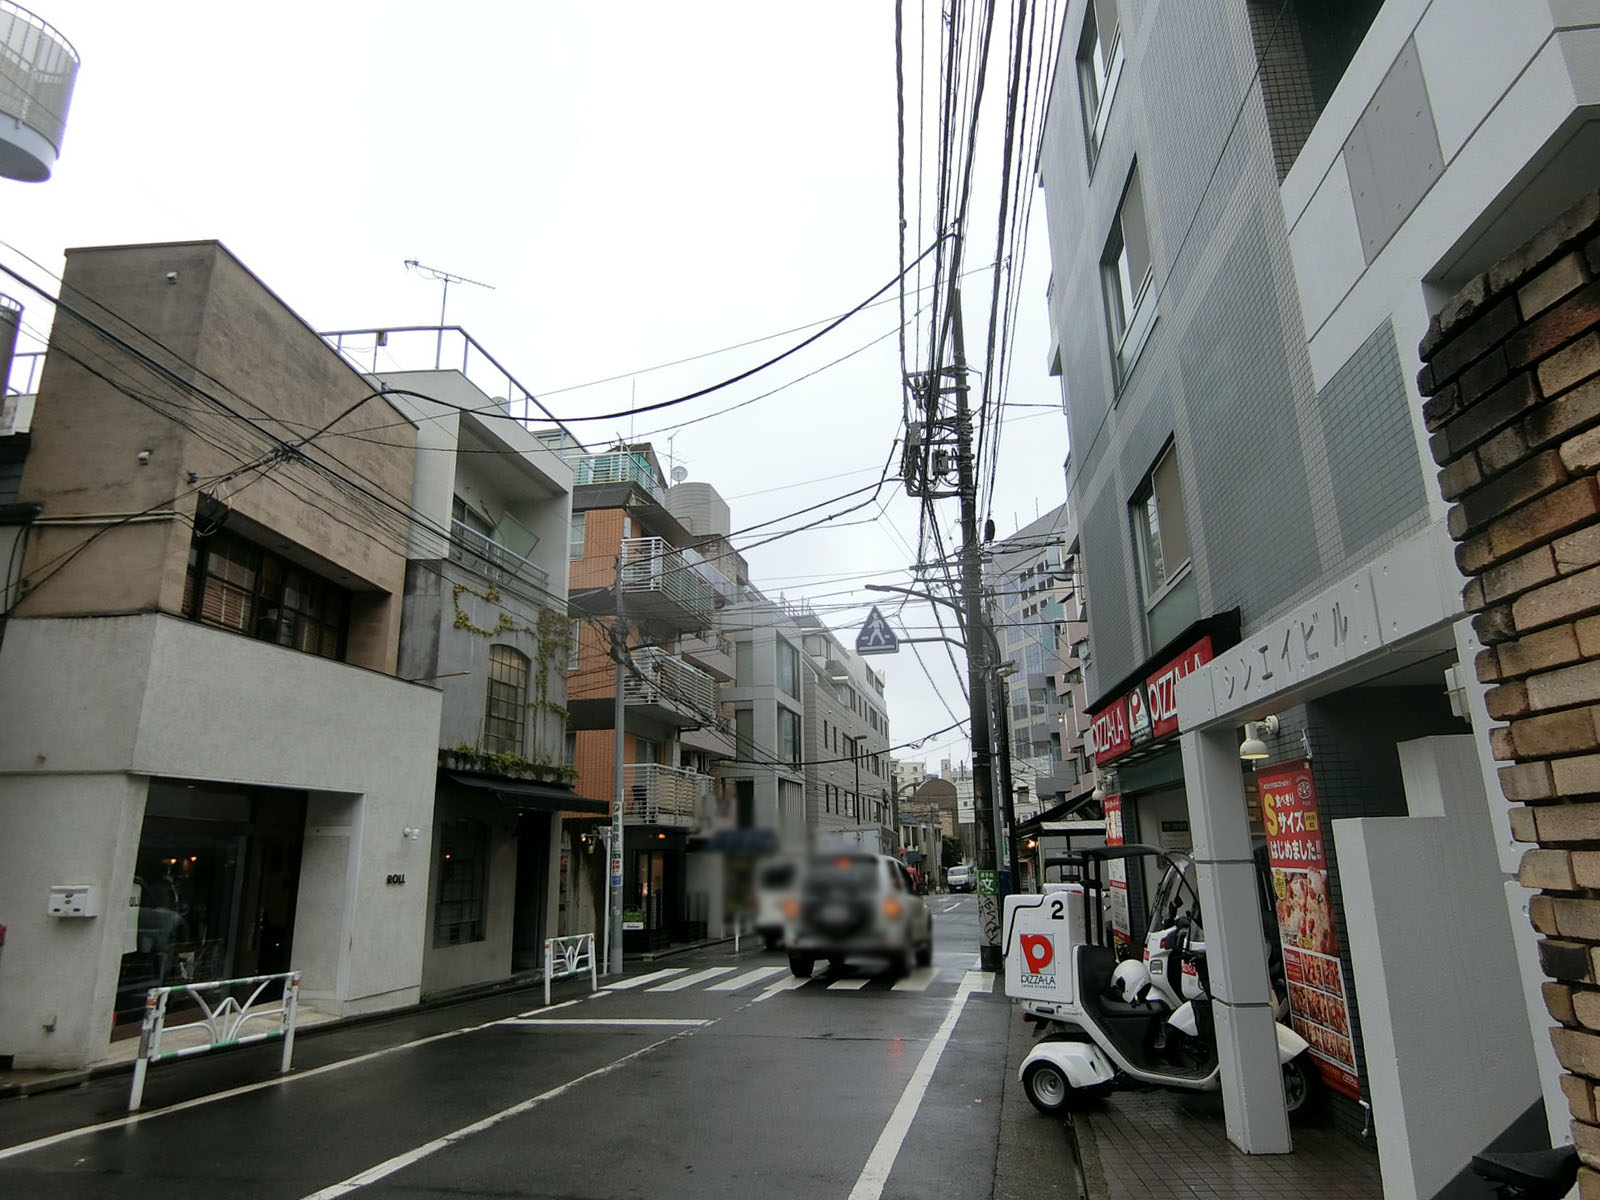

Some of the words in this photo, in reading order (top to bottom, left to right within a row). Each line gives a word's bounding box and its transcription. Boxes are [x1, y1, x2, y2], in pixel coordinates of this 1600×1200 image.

[1224, 602, 1348, 700] シンエイビル
[1275, 792, 1295, 808] 食べきり
[1263, 792, 1279, 836] S
[1278, 811, 1305, 834] サイズ
[386, 873, 406, 885] ROLL
[981, 877, 995, 892] 文
[1050, 900, 1064, 920] 2
[1021, 974, 1056, 986] PIZZA-LA
